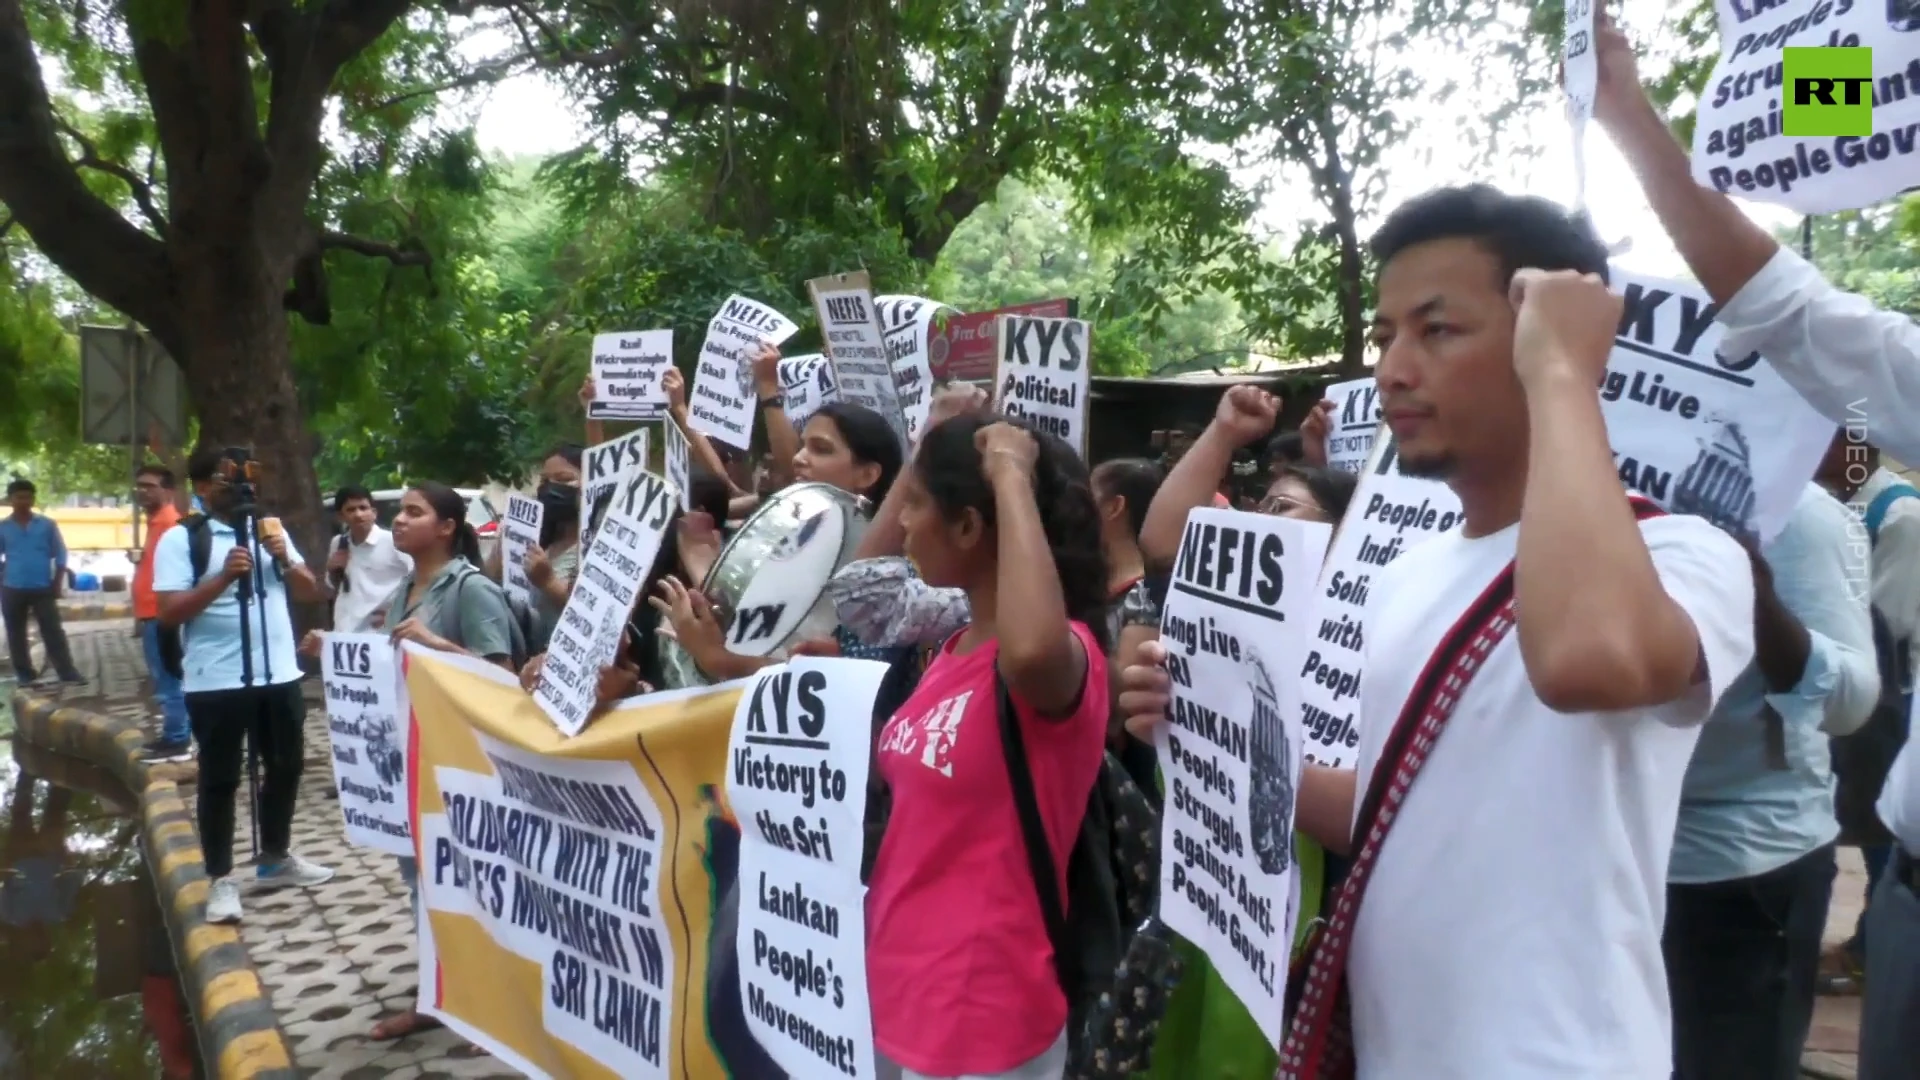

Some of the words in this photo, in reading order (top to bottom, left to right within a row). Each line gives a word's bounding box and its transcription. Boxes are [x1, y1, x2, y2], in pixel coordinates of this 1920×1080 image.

[1709, 143, 1832, 192] People
[725, 300, 782, 333] NEFIS
[826, 296, 867, 320] NEFIS
[706, 341, 737, 360] United
[1004, 317, 1083, 371] KYS
[1003, 373, 1076, 408] Political
[1628, 370, 1700, 420] Live
[588, 435, 640, 480] KYS
[509, 496, 538, 523] NEFIS
[617, 472, 670, 531] KYS
[1364, 493, 1437, 534] People
[1176, 521, 1285, 606] NEFIS
[1356, 534, 1406, 567] Indi
[332, 641, 371, 673] KYS
[1161, 603, 1197, 657] Long
[1199, 616, 1241, 663] Live
[1318, 614, 1363, 651] with
[342, 685, 379, 708] People
[1300, 650, 1362, 701] Peopl
[747, 669, 828, 738] KYS
[734, 746, 815, 808] Victory
[819, 759, 846, 802] to
[344, 808, 411, 838] Victorious!
[756, 809, 793, 852] the
[792, 815, 833, 862] Sri
[1172, 777, 1244, 858] Struggle
[554, 822, 611, 898] WITH
[615, 841, 652, 918] THE
[1172, 828, 1235, 899] against
[1236, 872, 1275, 938] Anti-
[512, 871, 630, 974] MOVEMENT
[629, 922, 664, 991] IN
[758, 871, 839, 939] Lankan
[1172, 861, 1228, 936] People
[1229, 913, 1275, 998] Govt.!
[753, 929, 845, 1010] People's
[551, 948, 587, 1020] SRI
[592, 974, 661, 1068] LANKA
[747, 982, 857, 1079] Movement!
